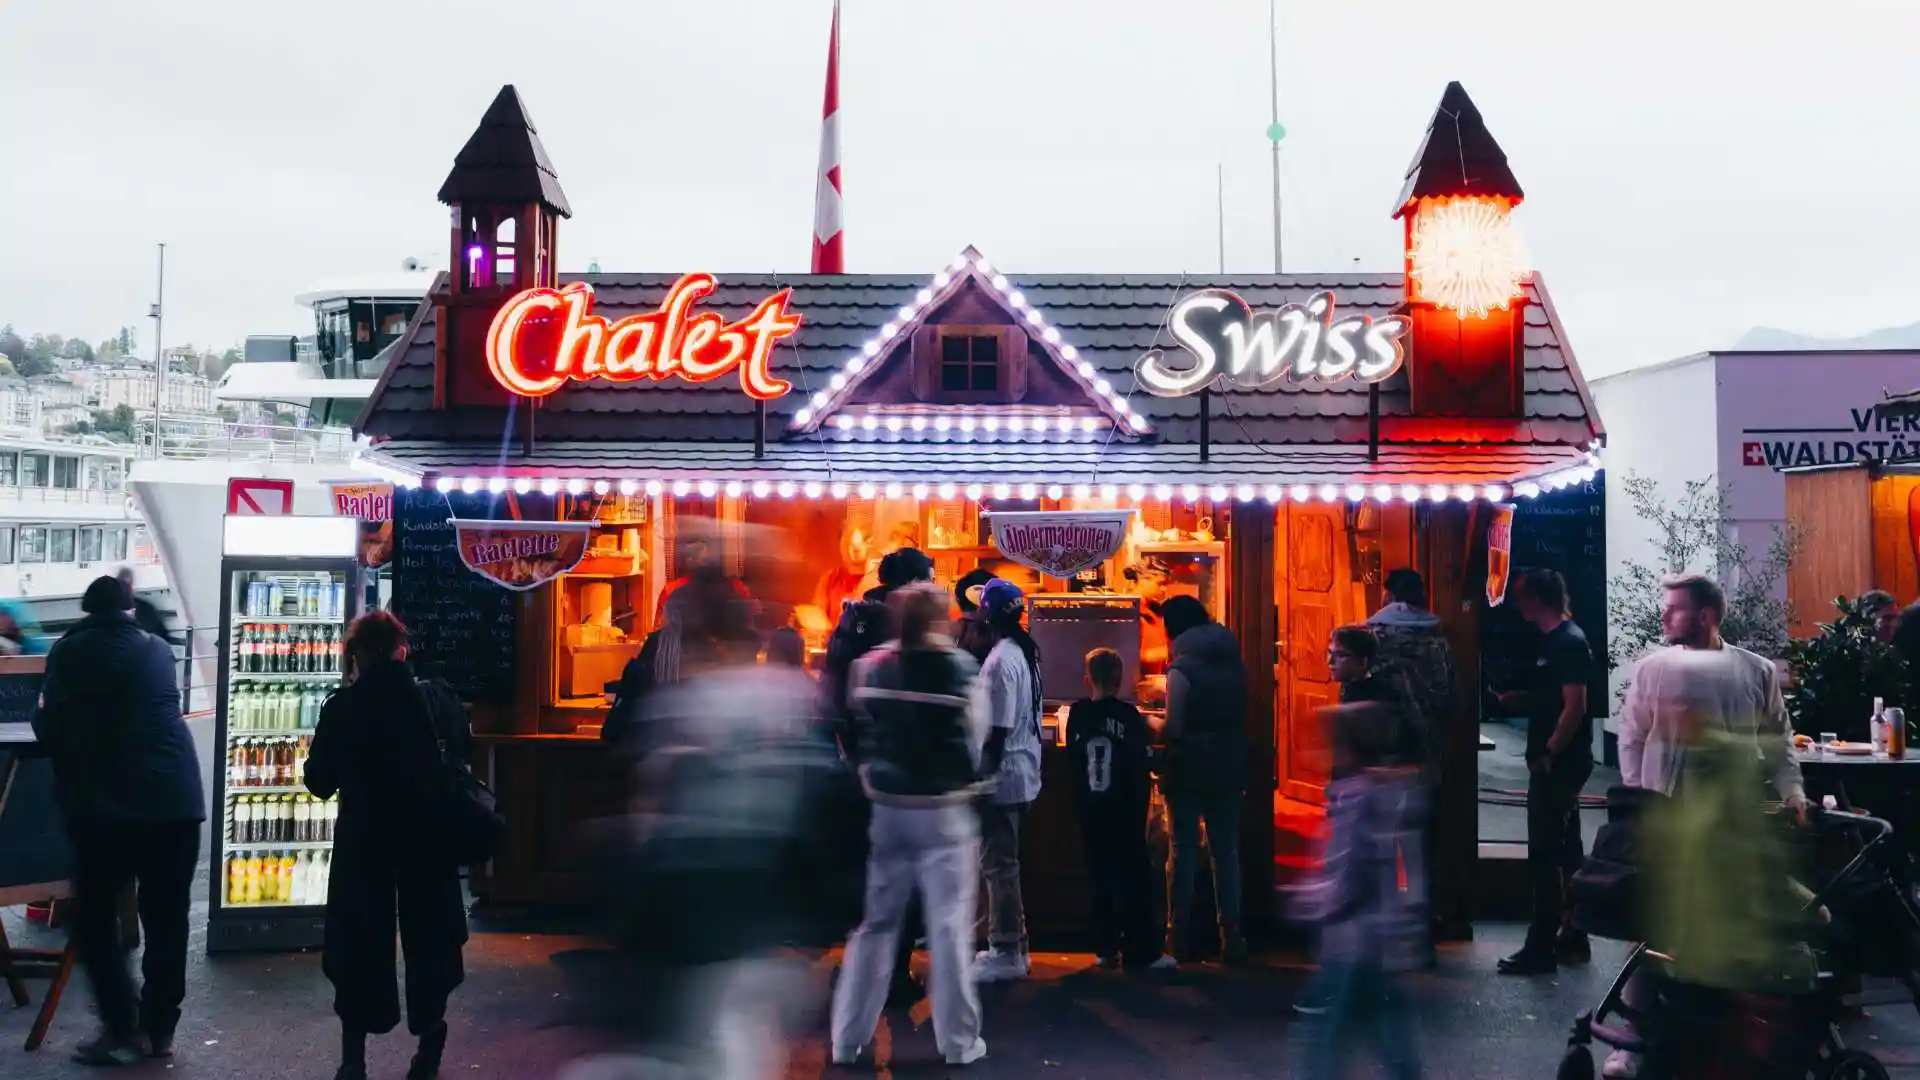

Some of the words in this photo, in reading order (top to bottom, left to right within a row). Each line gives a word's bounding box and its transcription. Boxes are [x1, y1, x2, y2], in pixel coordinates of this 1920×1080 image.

[486, 273, 803, 400] Chalet
[1134, 288, 1413, 397] Swiss
[1851, 408, 1920, 432] VIER
[336, 492, 394, 521] Raclett
[470, 532, 560, 565] Raclette
[1003, 522, 1112, 554] Älplermagronen
